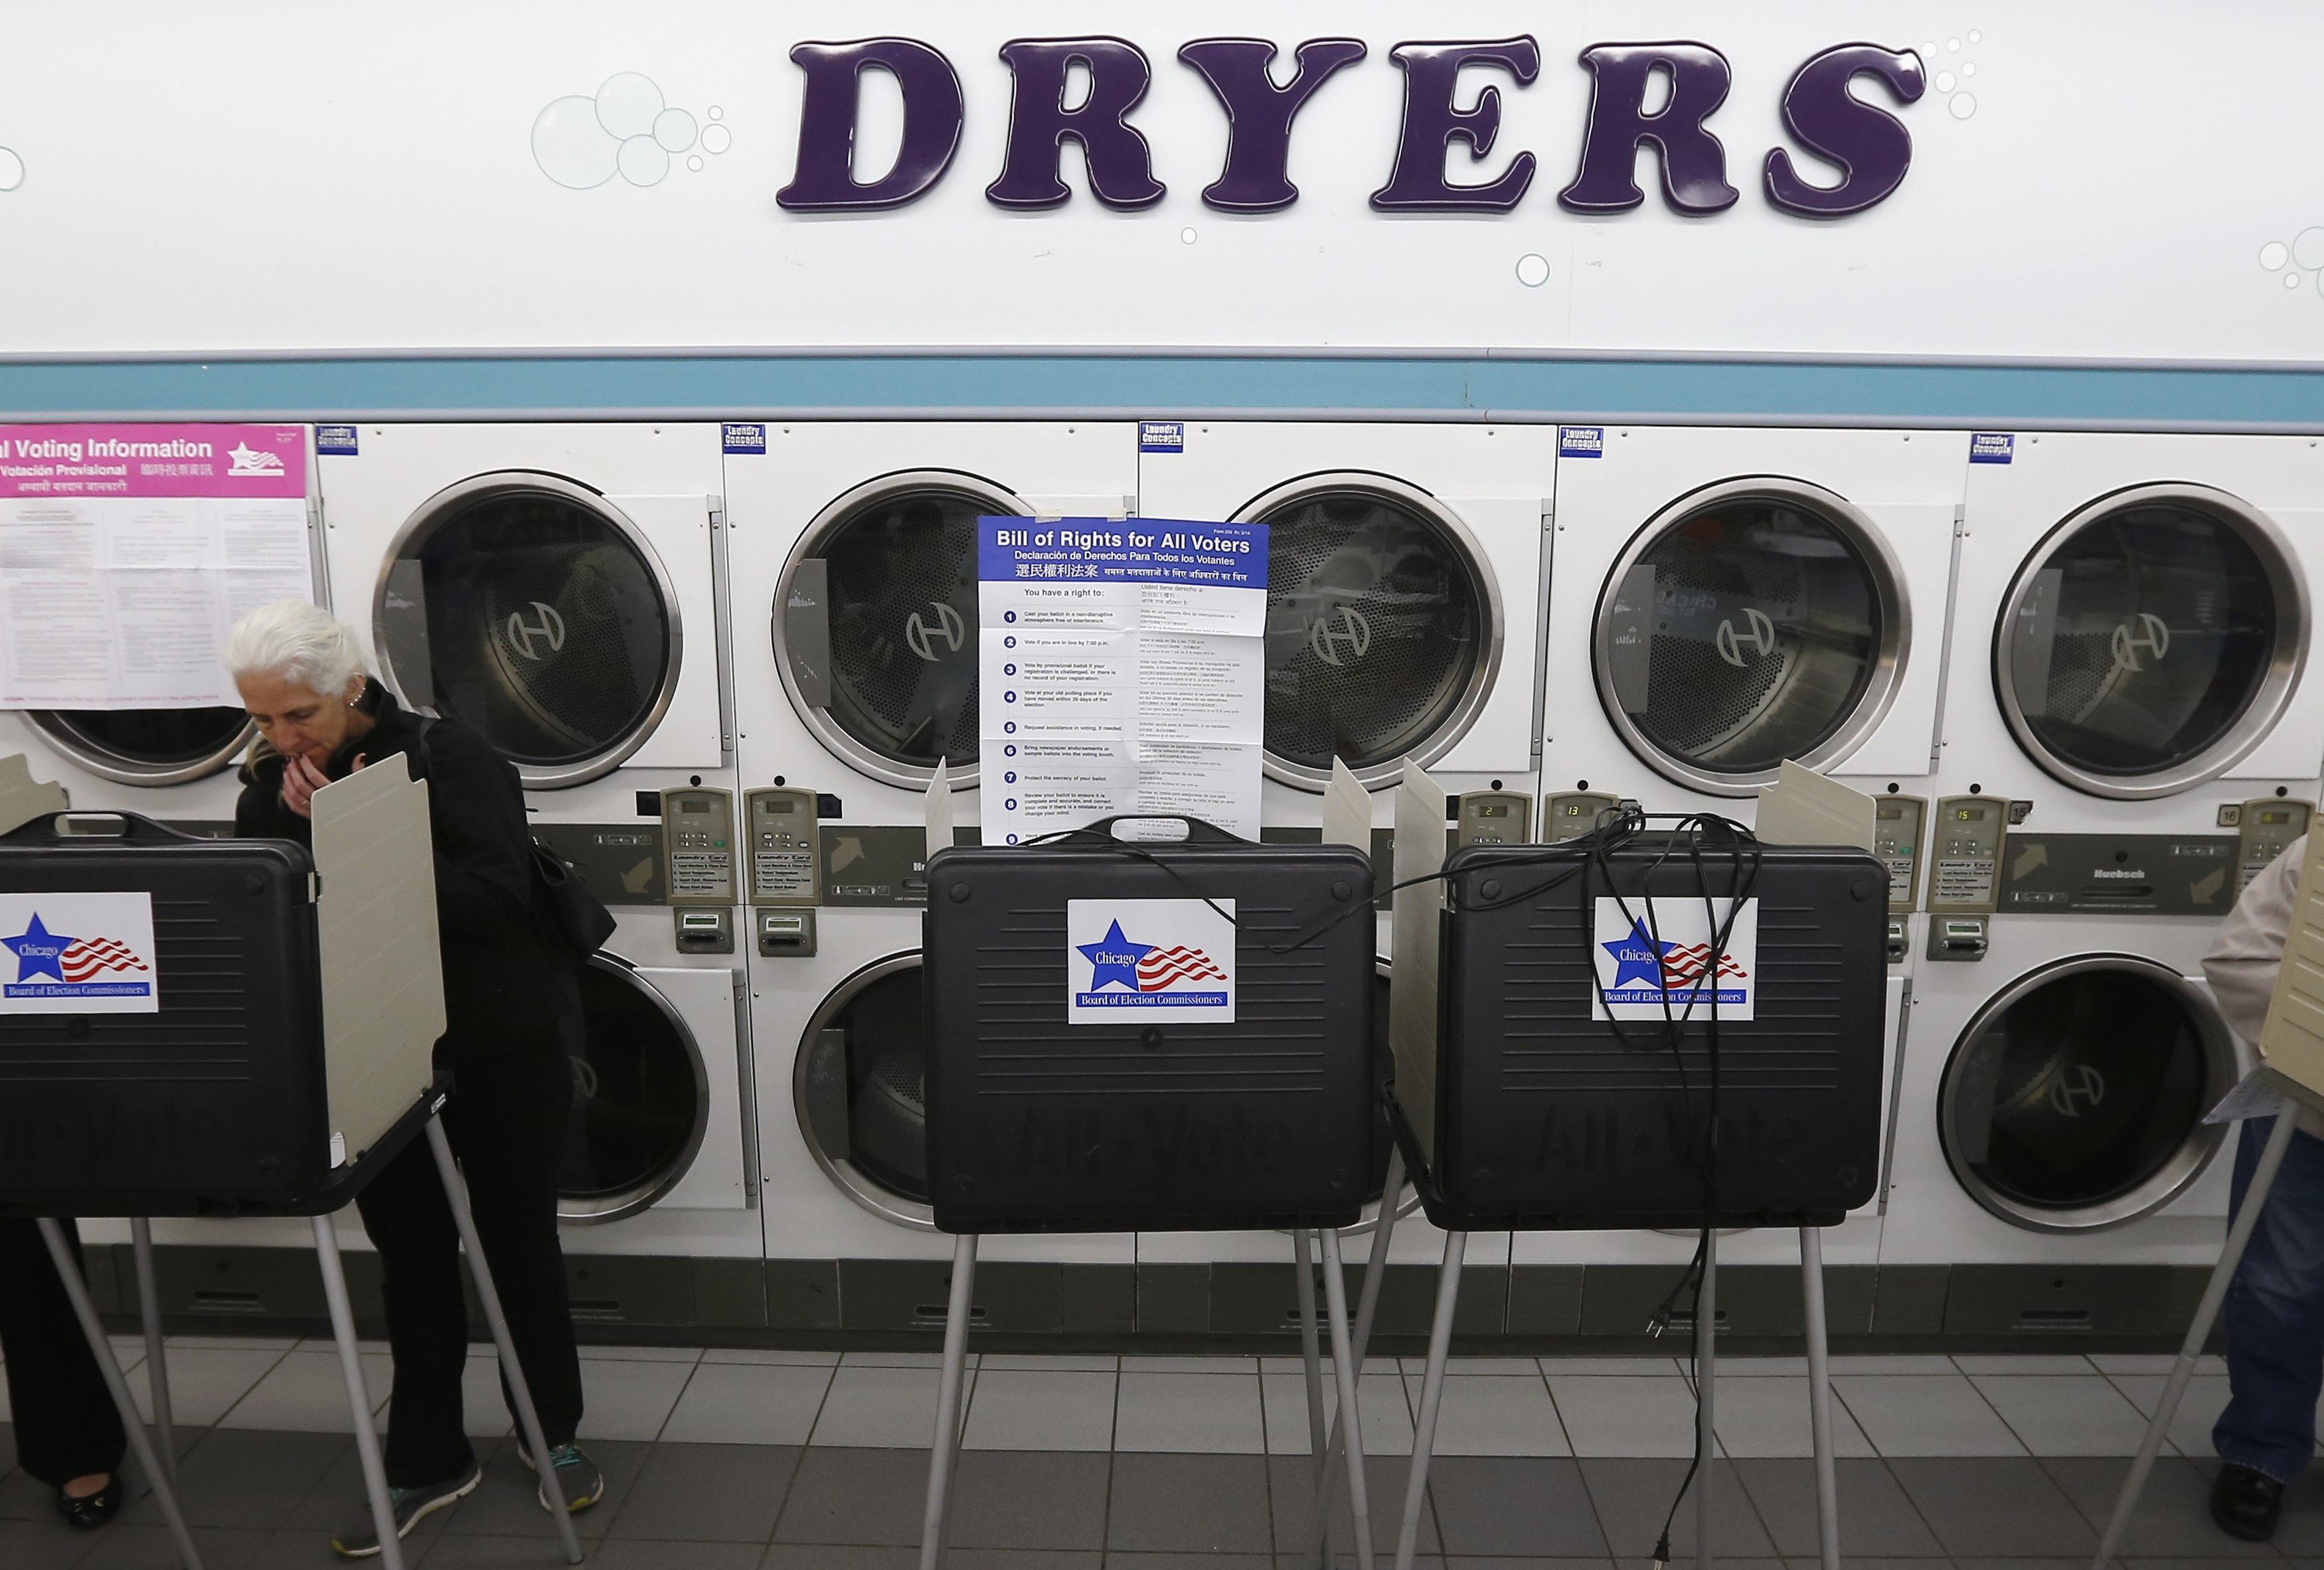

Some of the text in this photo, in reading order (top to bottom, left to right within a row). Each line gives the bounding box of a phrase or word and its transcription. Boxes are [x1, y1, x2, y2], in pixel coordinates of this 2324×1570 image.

[776, 35, 1926, 220] DRYERS
[727, 426, 760, 435] Laundry
[1145, 424, 1178, 434] Laundry
[1566, 429, 1598, 439] Laundry
[725, 435, 764, 444] Concepts
[1142, 433, 1181, 443] Concepts
[1562, 437, 1601, 448] Concepts
[15, 439, 82, 461] Voting
[88, 439, 212, 457] Information
[0, 464, 127, 477] Votación Provisional
[997, 530, 1250, 553] Bill of Rights for All Voters
[1015, 550, 1067, 560] Declaración
[1070, 551, 1081, 560] de
[1084, 552, 1127, 560] Derechos
[1153, 552, 1179, 562] Todos
[1181, 554, 1194, 563] los
[1197, 555, 1235, 566] Votantes
[1015, 564, 1098, 578] 選民權利法案
[1163, 568, 1169, 576] के
[1172, 569, 1187, 579] लिए
[1072, 589, 1090, 597] right
[1568, 806, 1579, 815] 13
[1959, 811, 1968, 820] 15
[2014, 807, 2026, 818] 15
[2224, 811, 2236, 821] 16
[2263, 813, 2273, 823] 16
[2094, 869, 2145, 879] Huebsch
[19, 944, 58, 960] Chicago
[1096, 951, 1135, 968] Chicago
[9, 985, 145, 996] Board of Election Commissioners
[1082, 994, 1223, 1005] Board of Election Commissioners
[1605, 992, 1630, 1002] Board
[1632, 991, 1641, 1001] of
